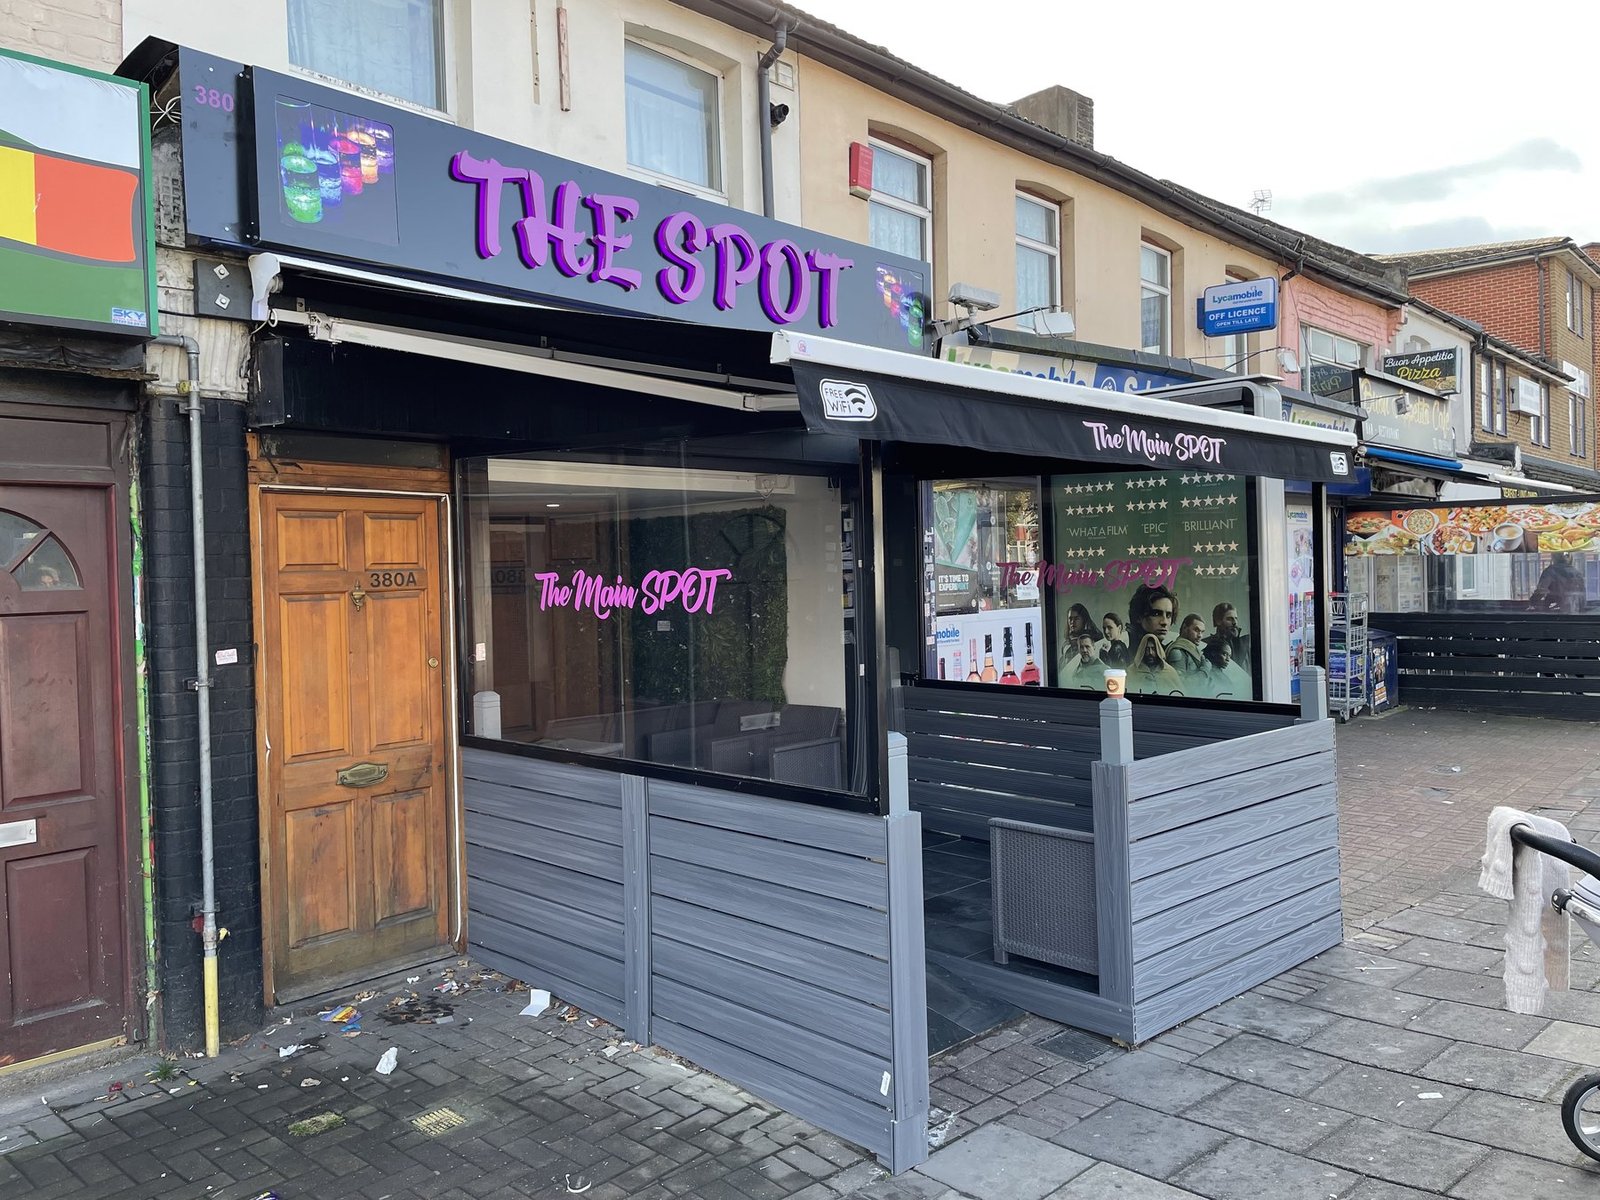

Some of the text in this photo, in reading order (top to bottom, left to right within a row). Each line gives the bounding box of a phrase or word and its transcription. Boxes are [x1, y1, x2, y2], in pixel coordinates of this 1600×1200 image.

[194, 83, 234, 112] 380
[449, 149, 856, 329] THE SPOT
[1212, 289, 1263, 304] Lycamobile
[112, 308, 145, 320] SKY
[1208, 306, 1267, 321] OFF LICENCE
[1384, 357, 1410, 368] Buon
[1396, 366, 1442, 381] Pizza
[824, 387, 844, 399] FREE
[826, 399, 852, 414] WiFi
[1082, 420, 1228, 464] The Main SPOT
[1098, 527, 1106, 536] A
[370, 571, 417, 588] 380A
[995, 561, 1035, 589] The
[1035, 559, 1099, 595] Main
[1103, 556, 1194, 592] SPOT
[534, 567, 733, 620] The Main SPOT
